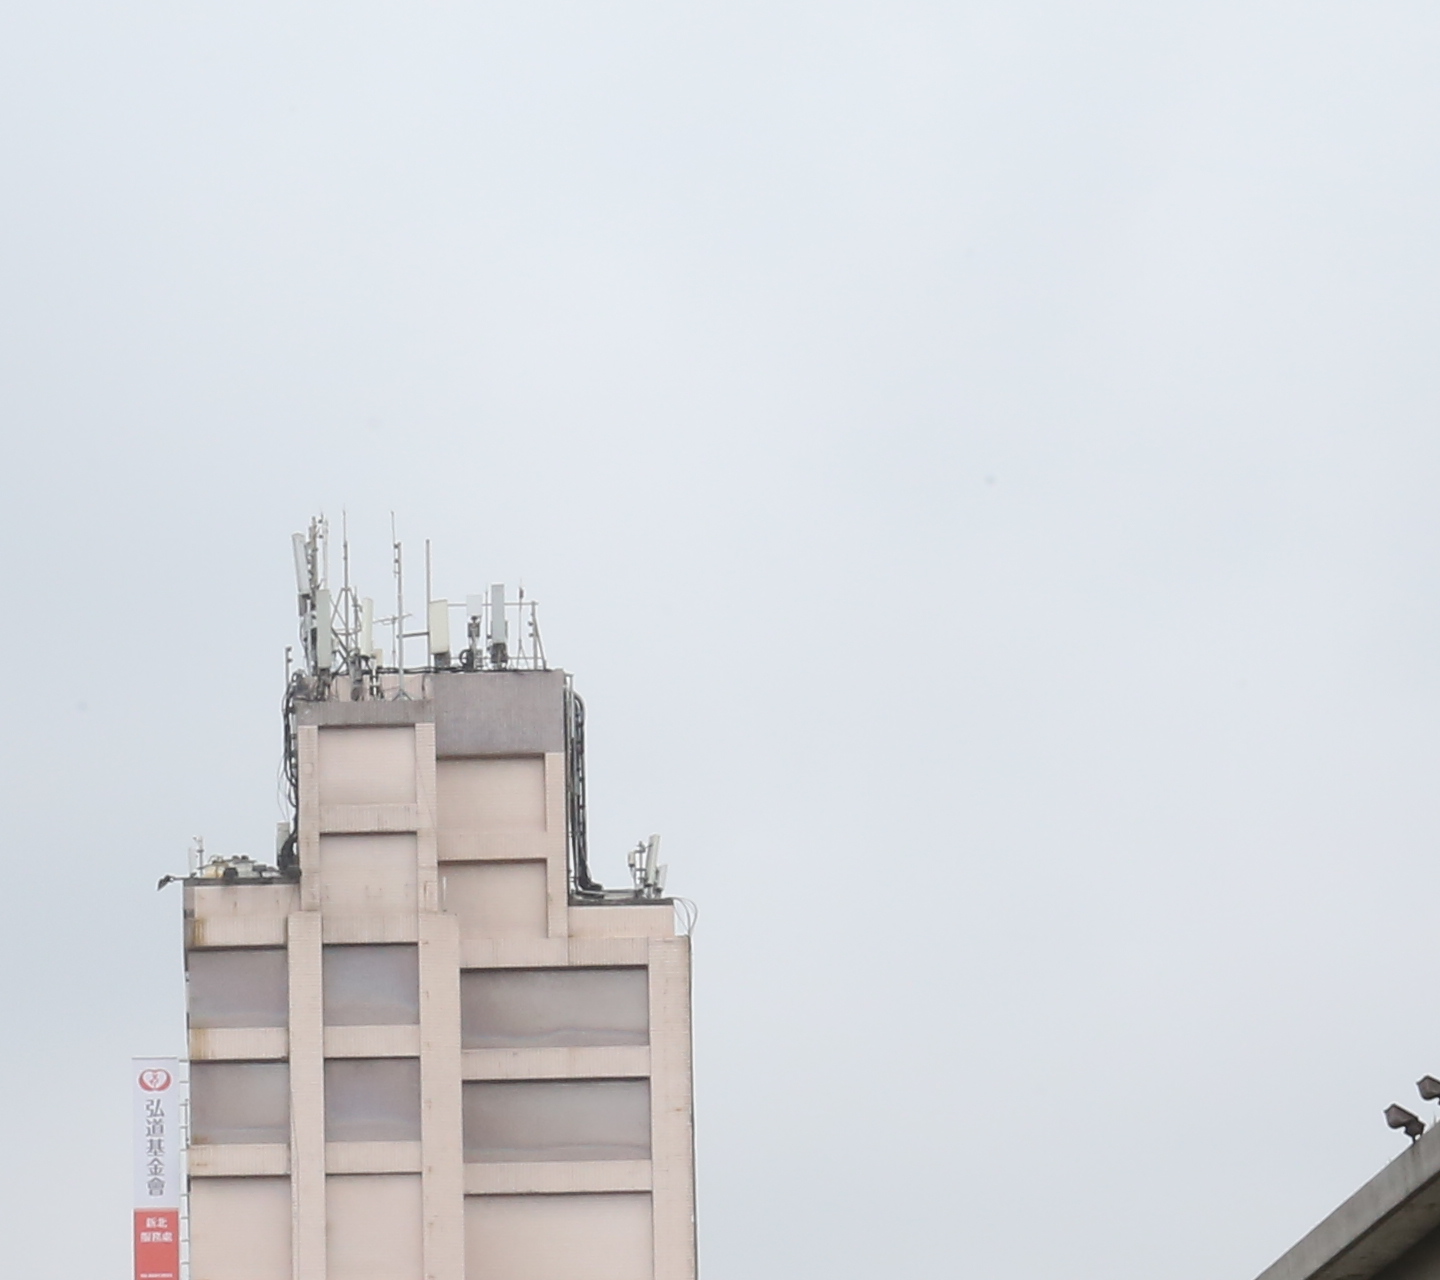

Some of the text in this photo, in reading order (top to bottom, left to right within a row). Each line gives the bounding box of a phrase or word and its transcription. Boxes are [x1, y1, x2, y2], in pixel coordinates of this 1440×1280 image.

[144, 1099, 166, 1197] 弘道基金會
